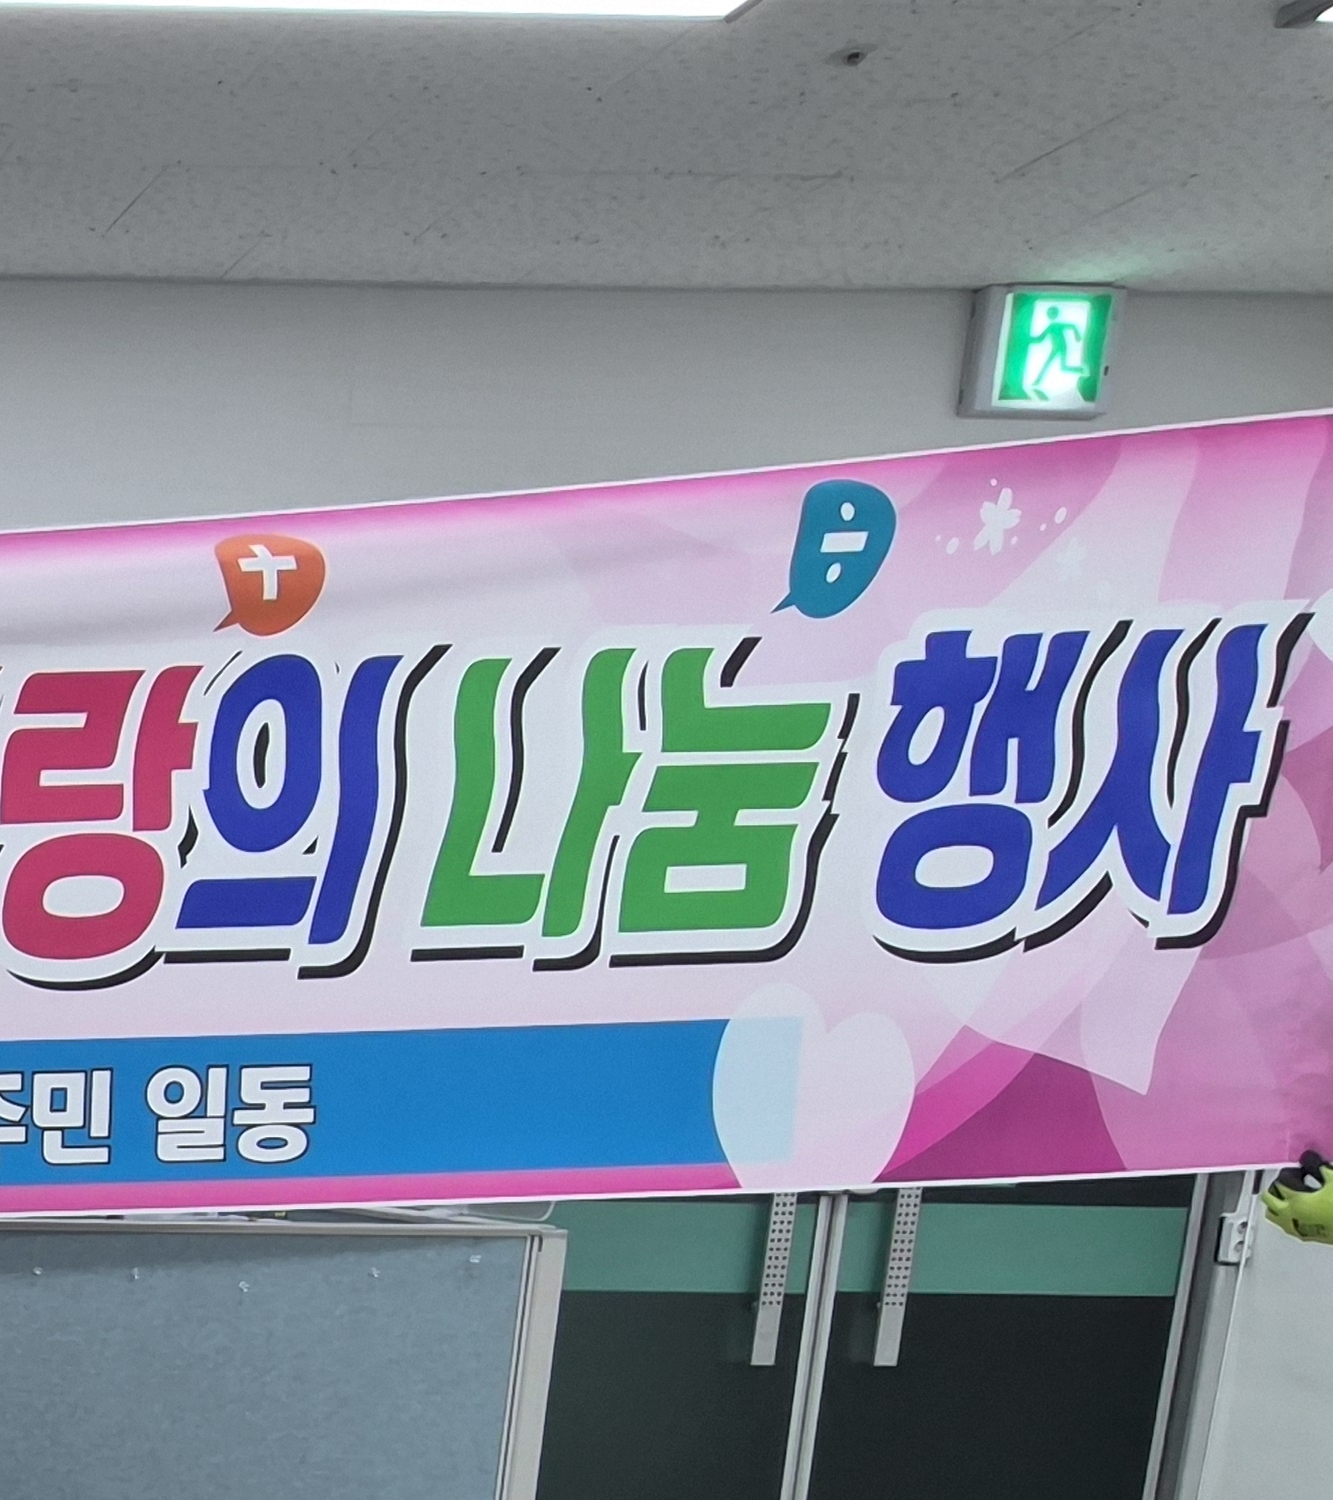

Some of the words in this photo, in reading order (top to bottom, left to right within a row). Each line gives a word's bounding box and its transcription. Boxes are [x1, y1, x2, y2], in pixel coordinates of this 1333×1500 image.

[420, 645, 833, 940] 나눔
[875, 622, 1271, 932] 행사
[145, 1064, 317, 1164] 일동
